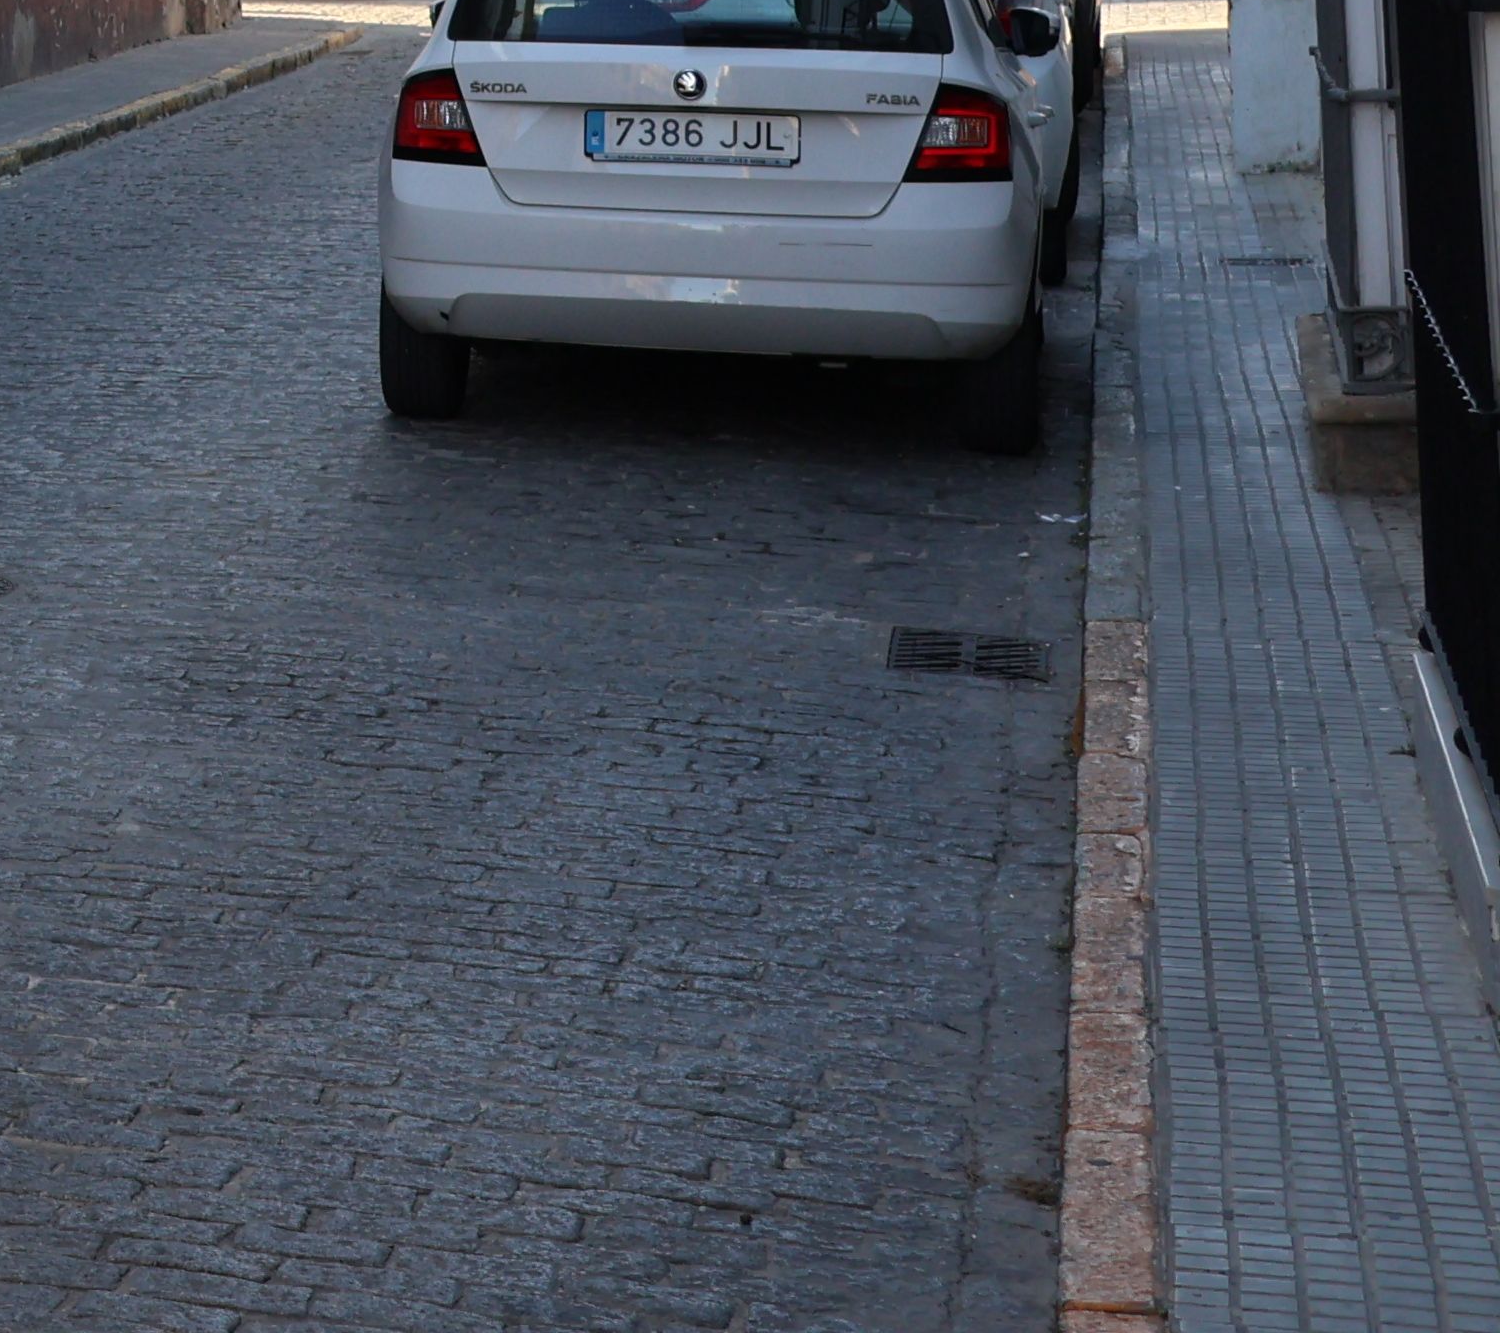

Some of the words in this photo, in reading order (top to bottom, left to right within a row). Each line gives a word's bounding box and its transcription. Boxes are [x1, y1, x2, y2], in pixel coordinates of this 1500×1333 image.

[469, 80, 528, 94] ŠKODA
[866, 93, 921, 106] FABIA
[615, 117, 704, 148] 7386
[719, 120, 785, 151] JJL
